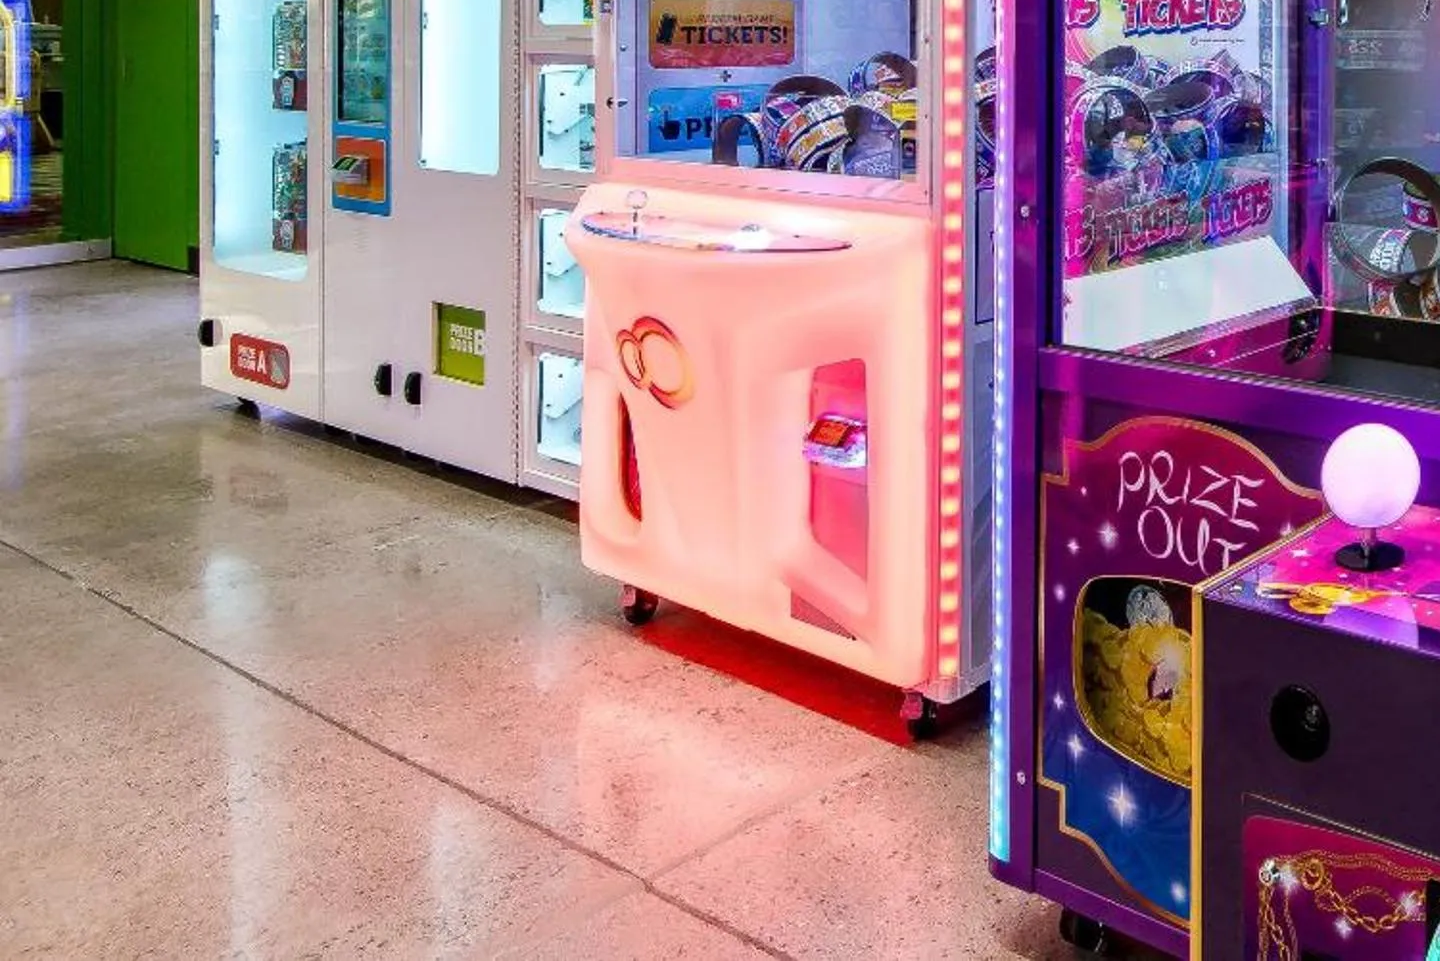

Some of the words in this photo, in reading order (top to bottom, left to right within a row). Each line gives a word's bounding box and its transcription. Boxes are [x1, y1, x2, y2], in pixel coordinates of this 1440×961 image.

[681, 26, 788, 44] TICKETS!
[257, 350, 267, 374] A
[1117, 449, 1266, 532] PRIZE
[1137, 505, 1248, 576] OUT
